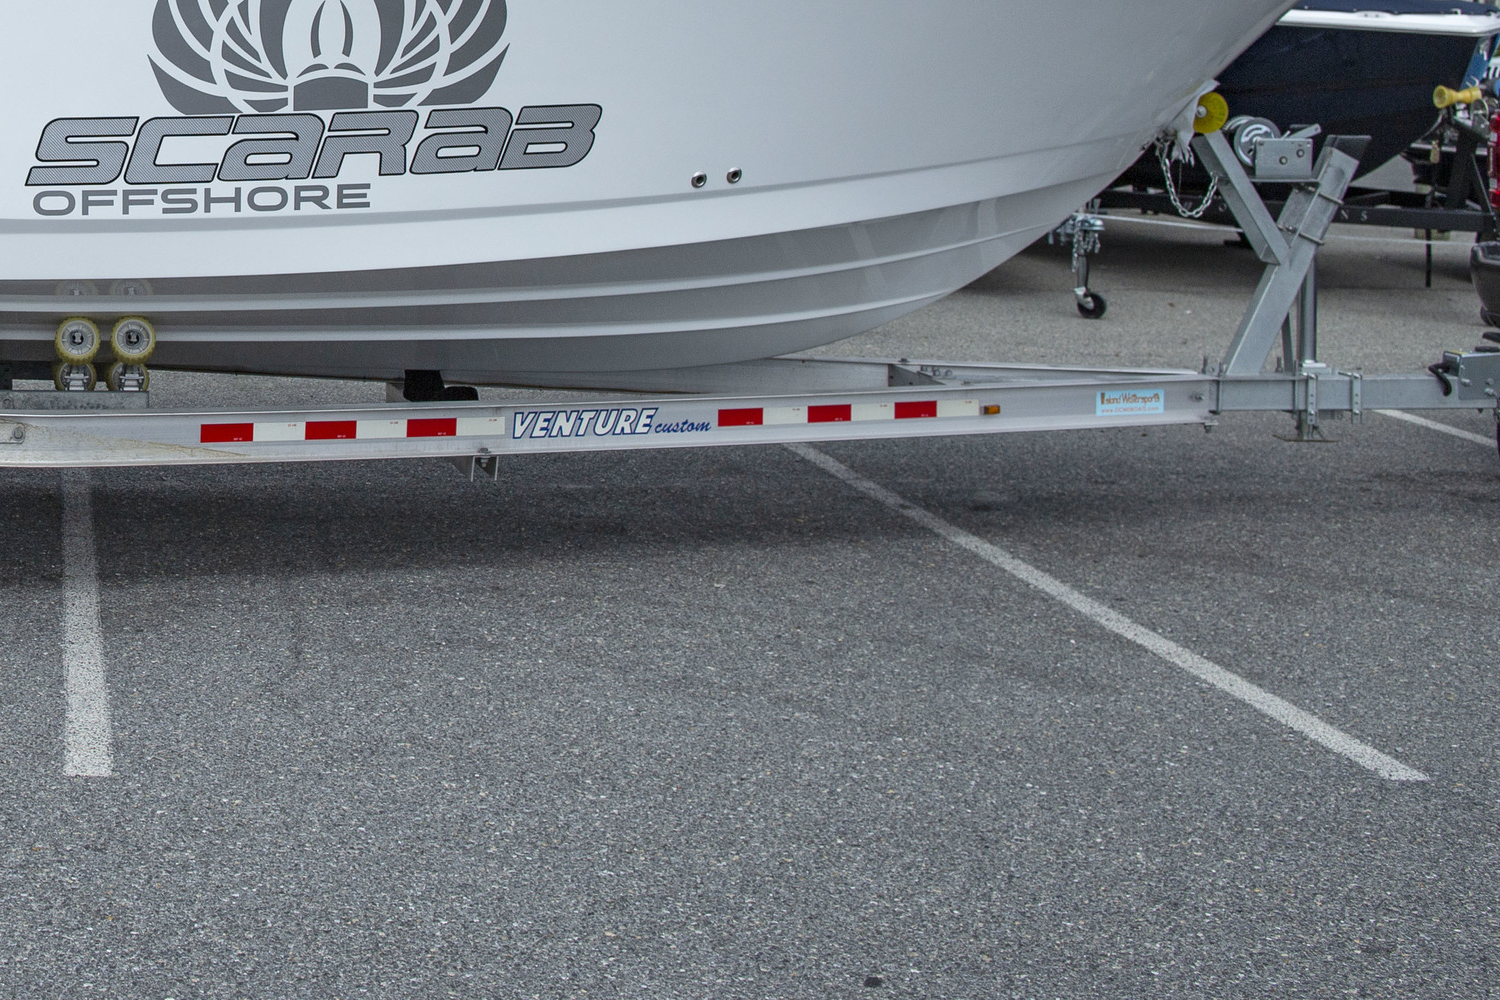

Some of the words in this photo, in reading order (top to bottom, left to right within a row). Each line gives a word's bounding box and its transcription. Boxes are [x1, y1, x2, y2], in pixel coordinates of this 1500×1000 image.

[32, 183, 371, 216] OFFSHORE
[513, 407, 659, 439] VENTURE
[654, 419, 711, 434] custom
